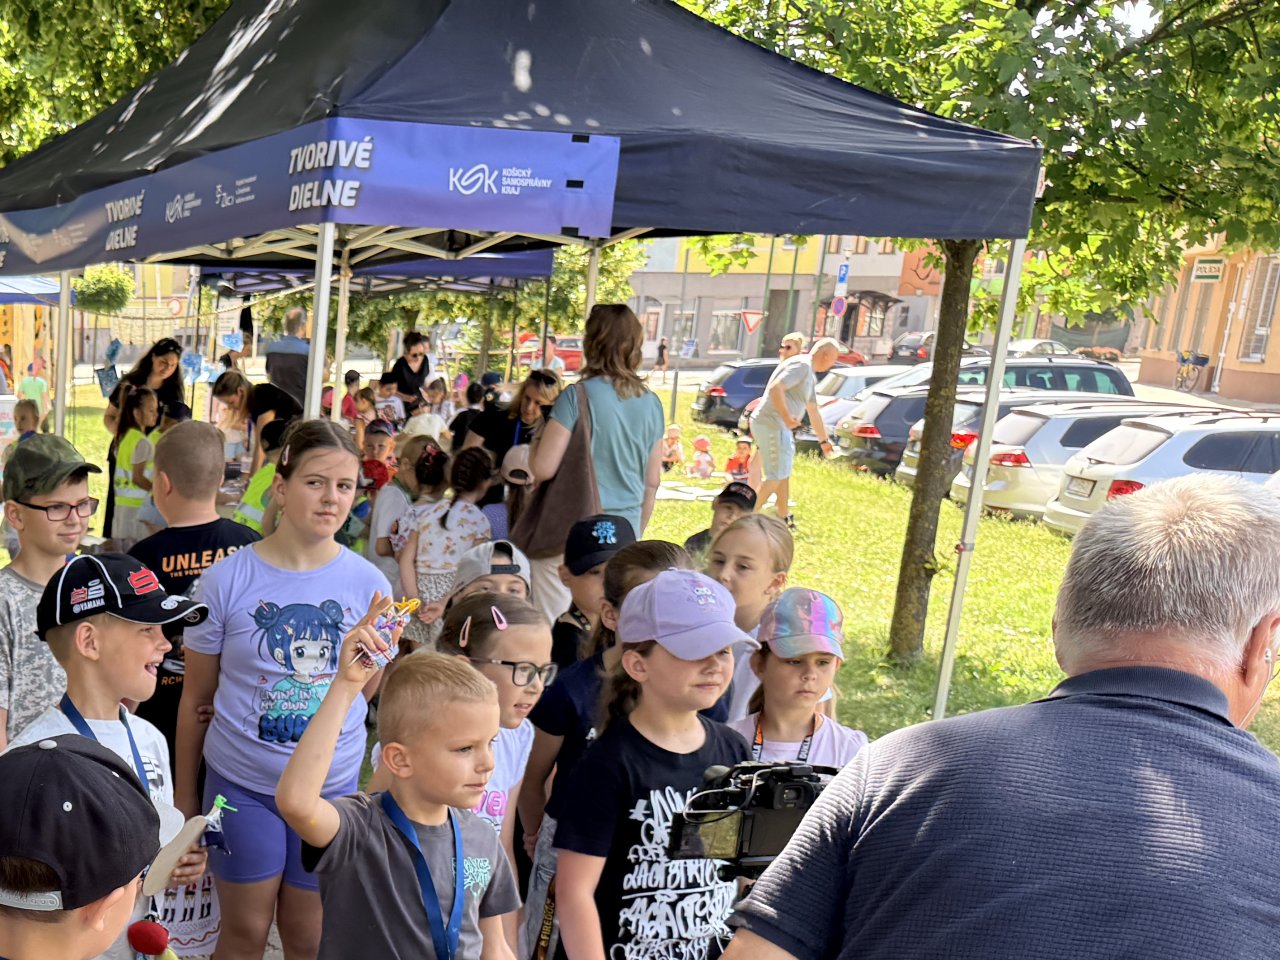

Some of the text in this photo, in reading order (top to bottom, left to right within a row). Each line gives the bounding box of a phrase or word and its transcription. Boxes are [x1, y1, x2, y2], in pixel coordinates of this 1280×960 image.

[288, 136, 374, 175] TVORIVÉ
[501, 166, 532, 179] KOŠICKÝ
[501, 175, 553, 189] SAMOSPRÁVNY
[288, 179, 361, 212] DIELNE
[500, 186, 521, 196] KRAJ
[161, 545, 245, 573] UNLEAS
[81, 598, 106, 612] YAMAHA
[299, 688, 312, 700] IN
[260, 700, 309, 711] MY OWN
